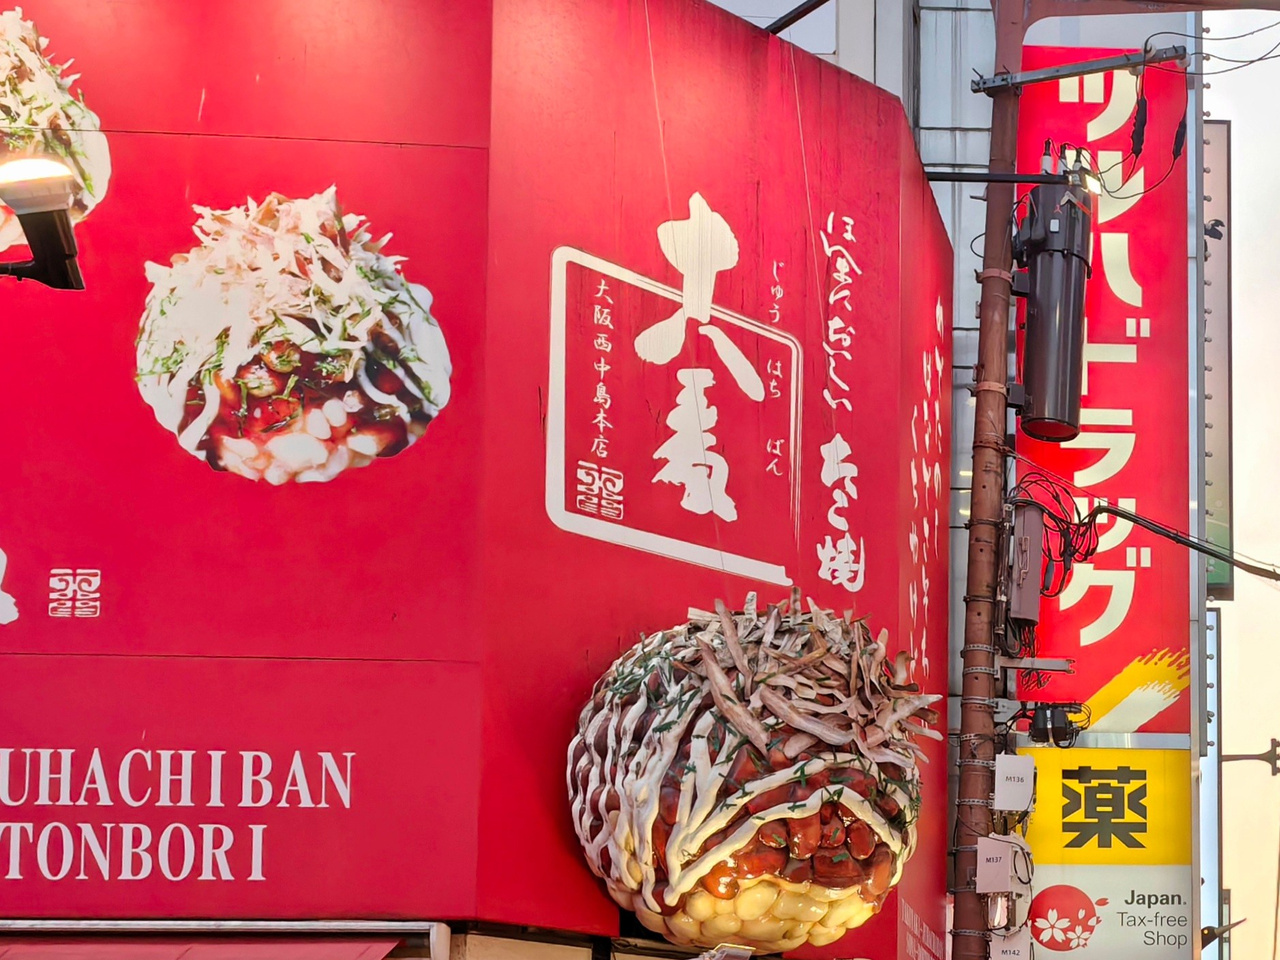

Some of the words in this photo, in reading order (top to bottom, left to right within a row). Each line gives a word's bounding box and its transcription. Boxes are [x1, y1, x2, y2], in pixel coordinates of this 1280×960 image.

[590, 278, 616, 459] 大阪西中島本店
[1062, 766, 1148, 849] 薬
[1124, 889, 1187, 909] Japan.
[1116, 911, 1188, 927] Tax-free
[1143, 930, 1188, 949] Shop
